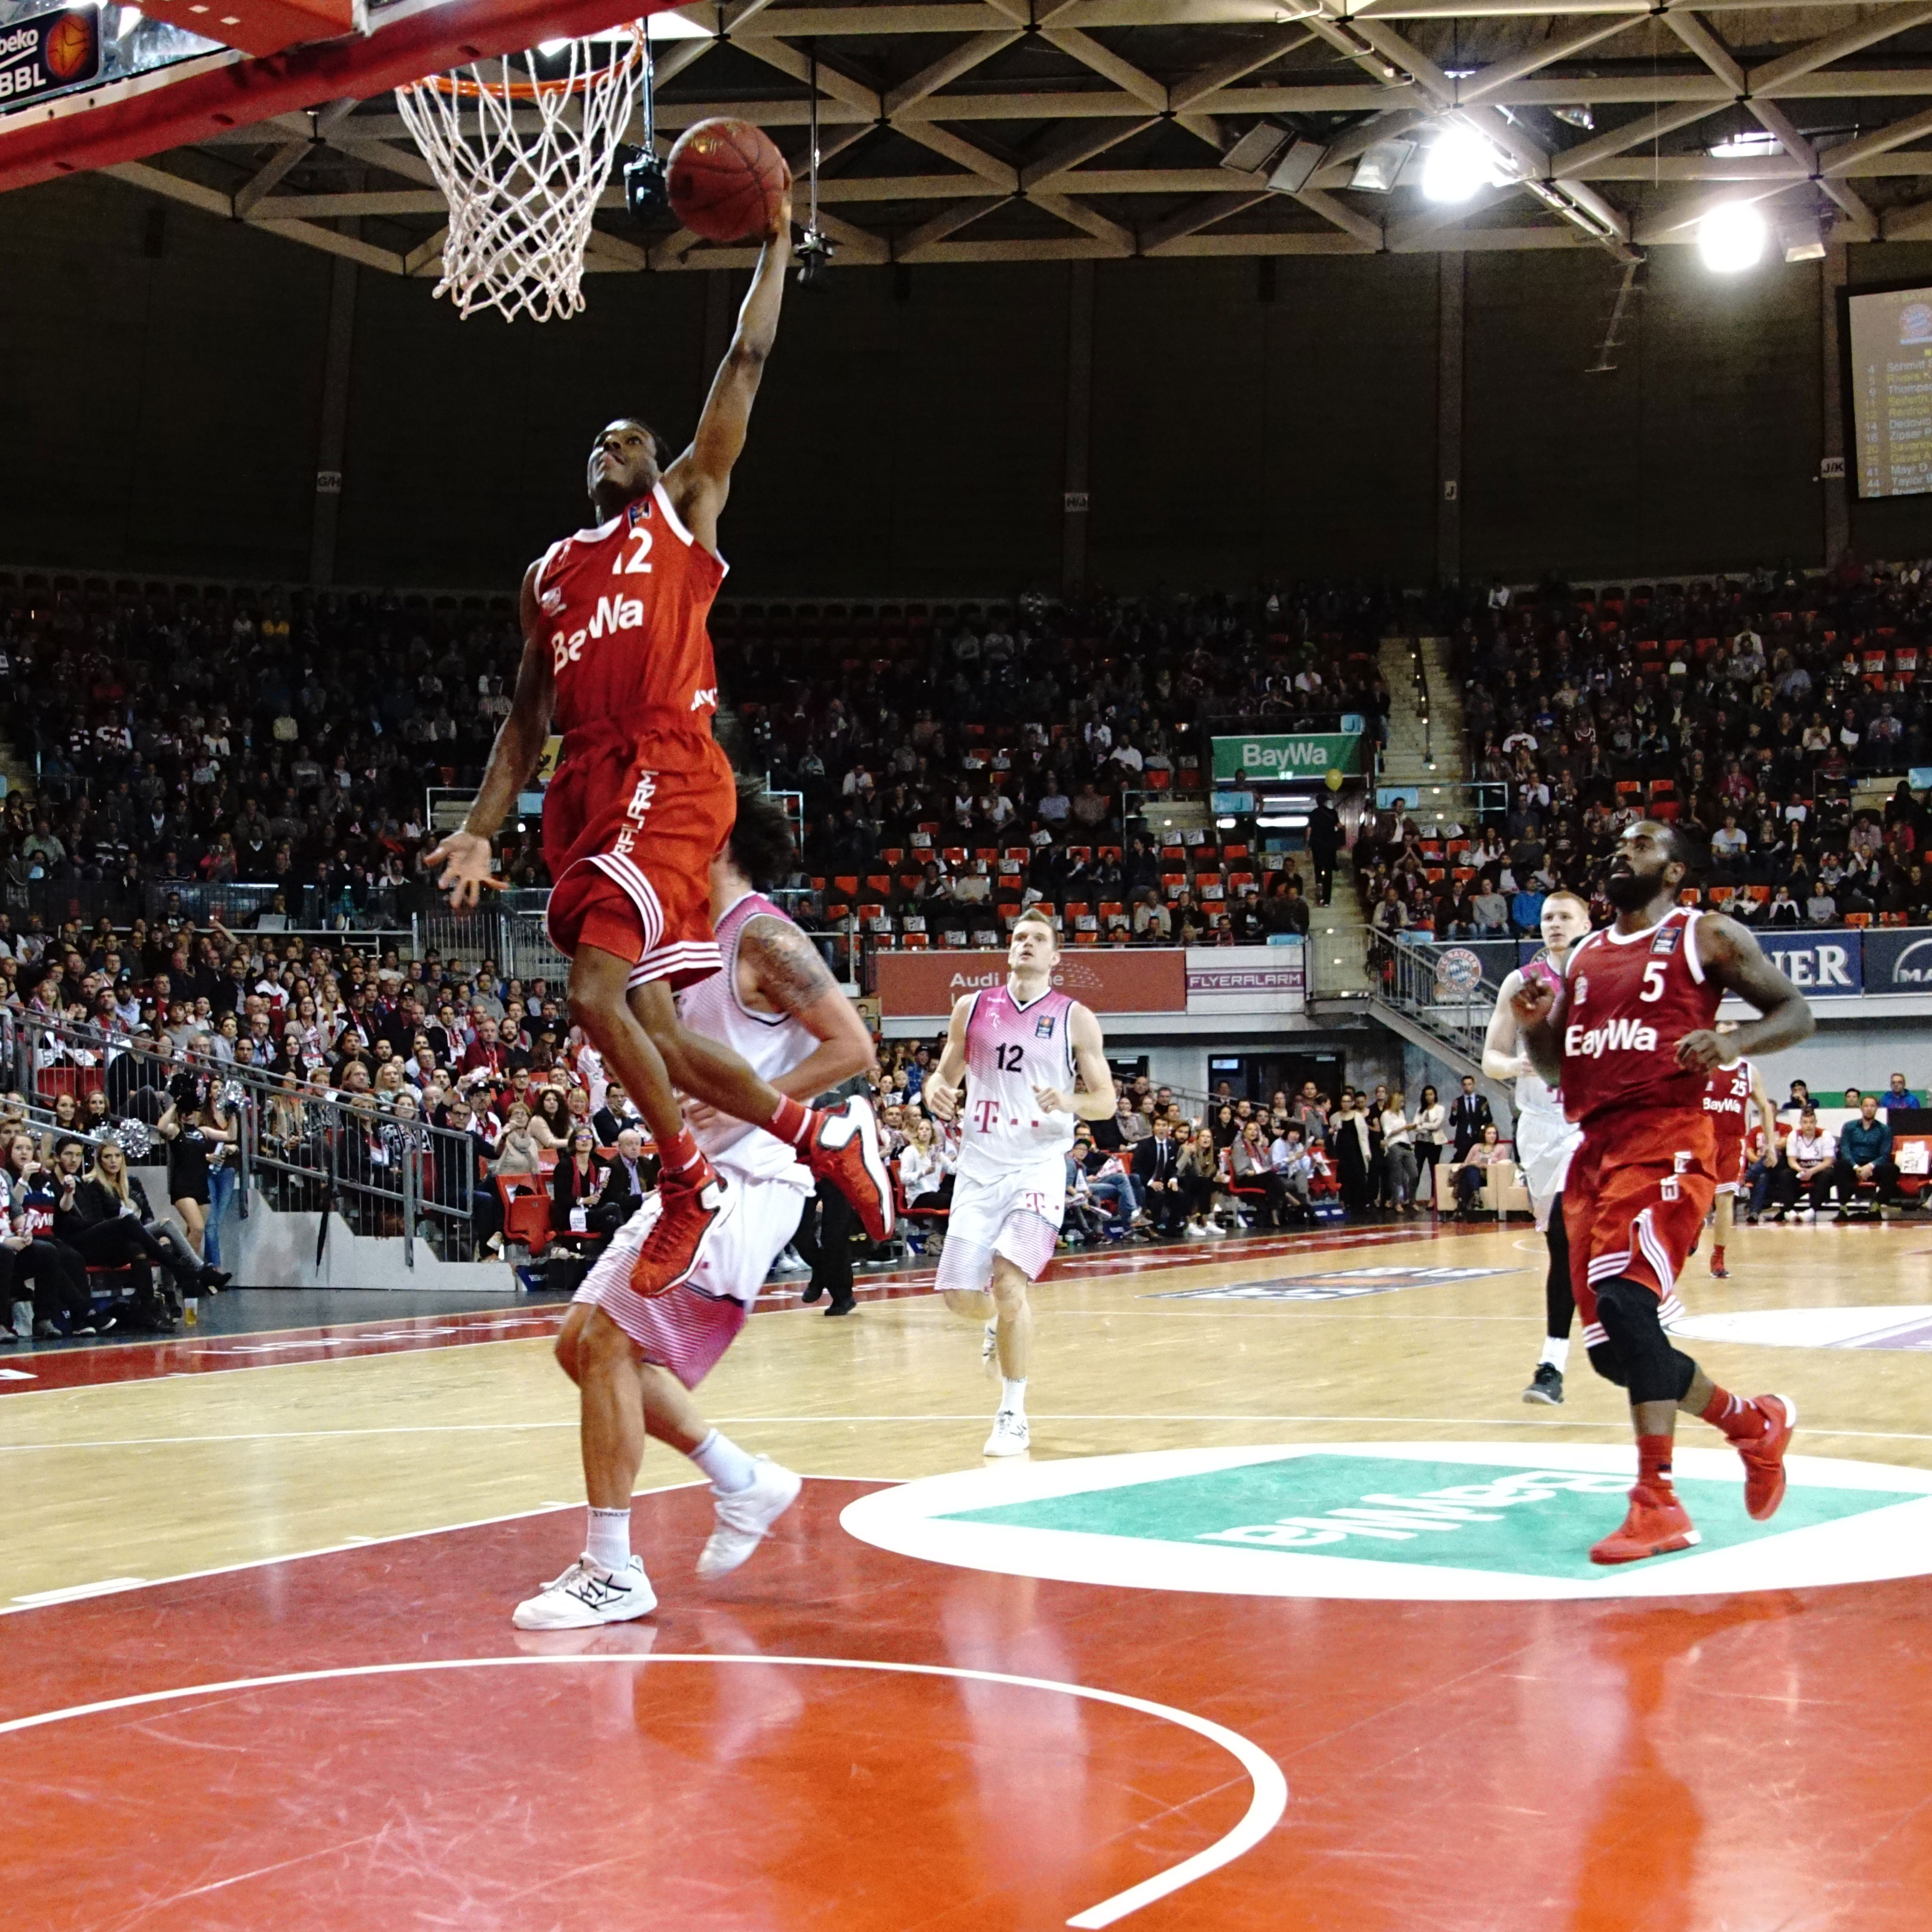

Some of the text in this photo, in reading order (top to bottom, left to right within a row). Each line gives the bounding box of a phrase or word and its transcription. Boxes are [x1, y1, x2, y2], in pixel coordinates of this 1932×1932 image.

[1243, 742, 1327, 769] BayWa
[950, 972, 999, 987] Audi
[1189, 974, 1301, 987] FLYERALARM
[1639, 961, 1667, 1002] 5
[996, 1043, 1024, 1073] 12
[1730, 1078, 1747, 1097] 25
[1703, 1097, 1742, 1113] BayWa
